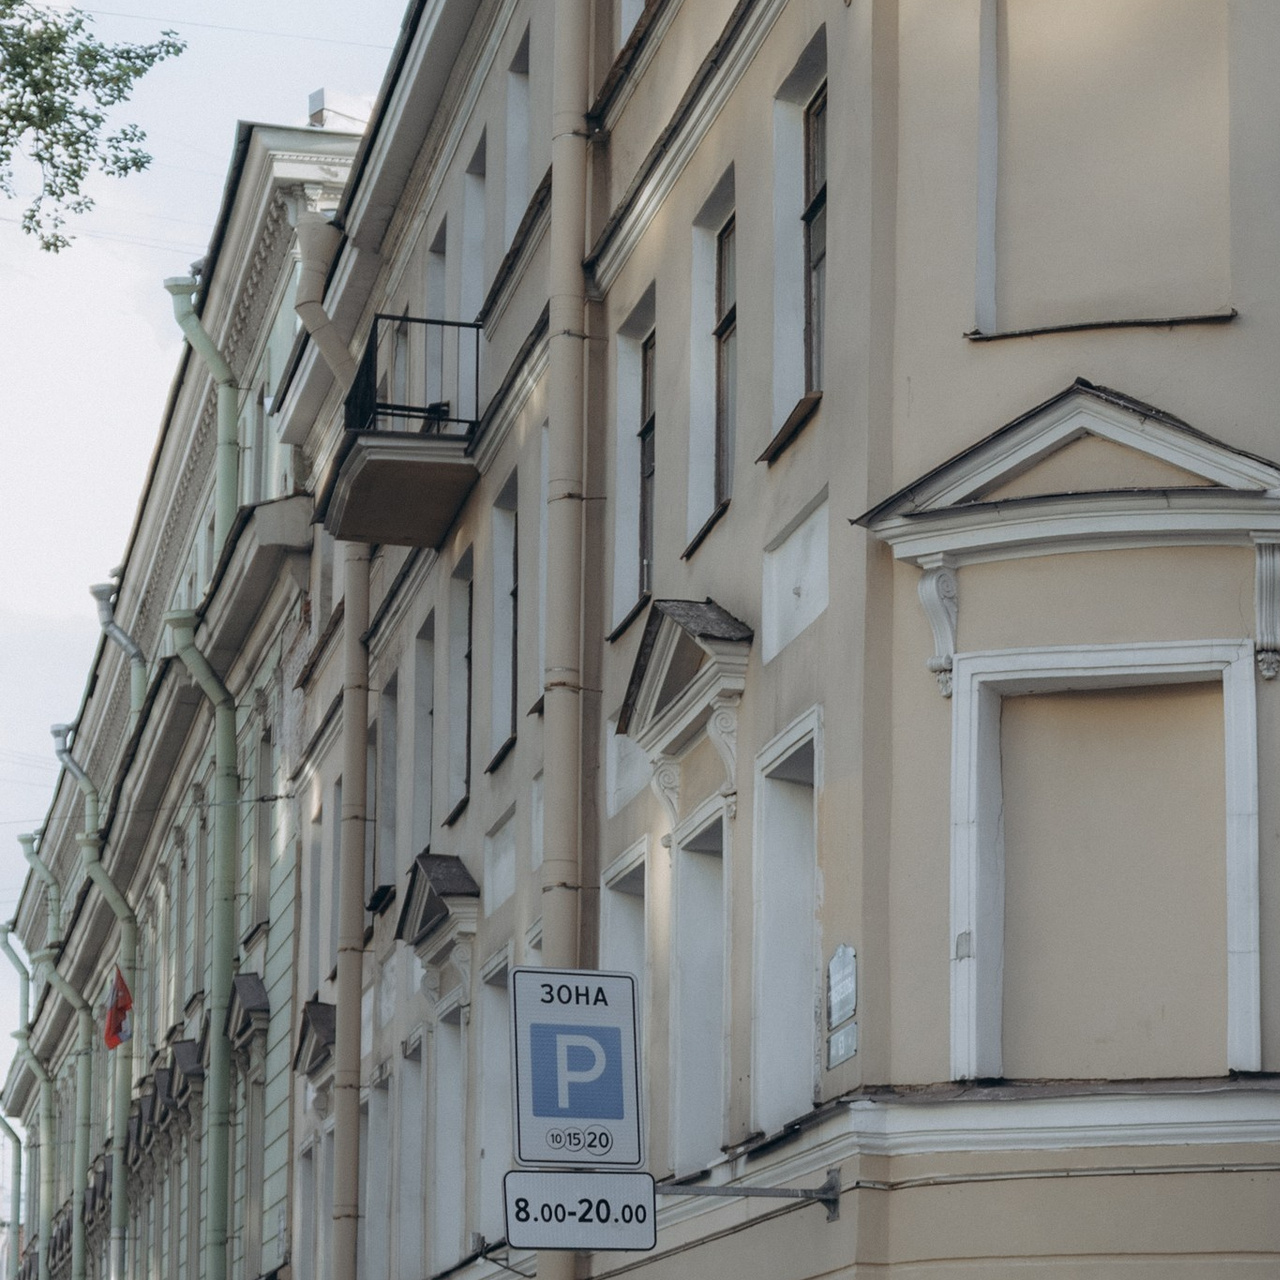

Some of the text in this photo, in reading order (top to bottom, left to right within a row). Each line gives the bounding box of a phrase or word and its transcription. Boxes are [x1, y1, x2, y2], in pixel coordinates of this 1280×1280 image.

[541, 983, 609, 1007] ЗОНА
[556, 1033, 607, 1109] P
[550, 1131, 609, 1149] 10 15 20
[514, 1197, 648, 1224] 8.00-20.00
